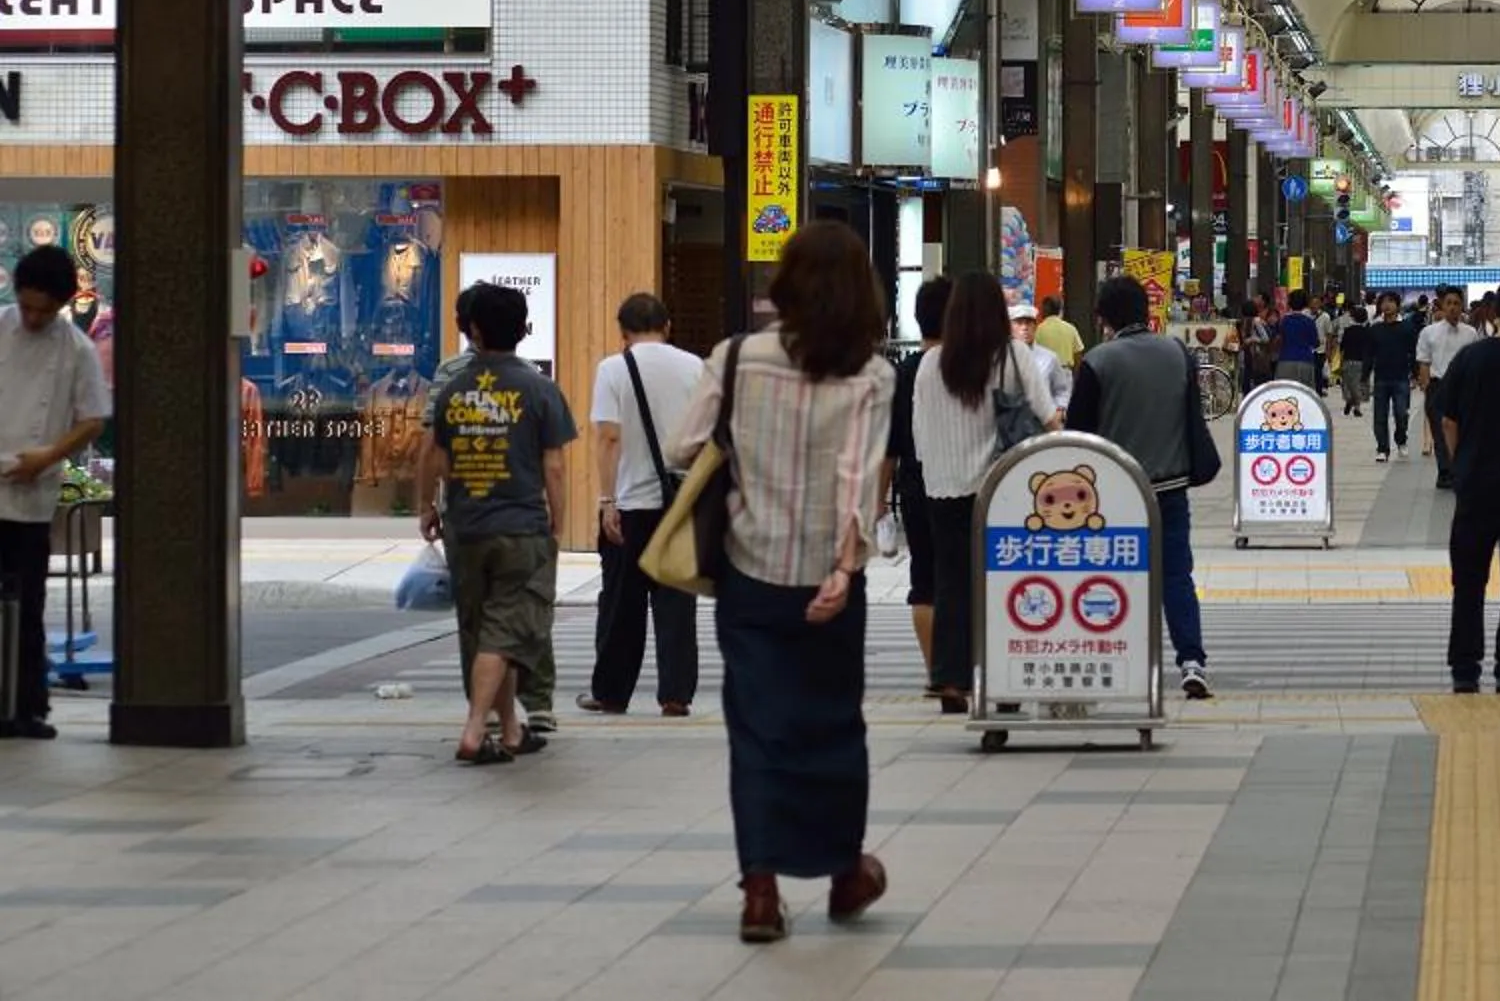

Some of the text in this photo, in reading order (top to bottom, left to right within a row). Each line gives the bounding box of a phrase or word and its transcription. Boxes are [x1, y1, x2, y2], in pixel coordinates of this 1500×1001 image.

[753, 102, 775, 197] 通行禁止
[1245, 433, 1322, 451] 歩行者専用
[996, 534, 1140, 567] 歩行者専用
[1007, 638, 1128, 656] 防犯カメラ作動中
